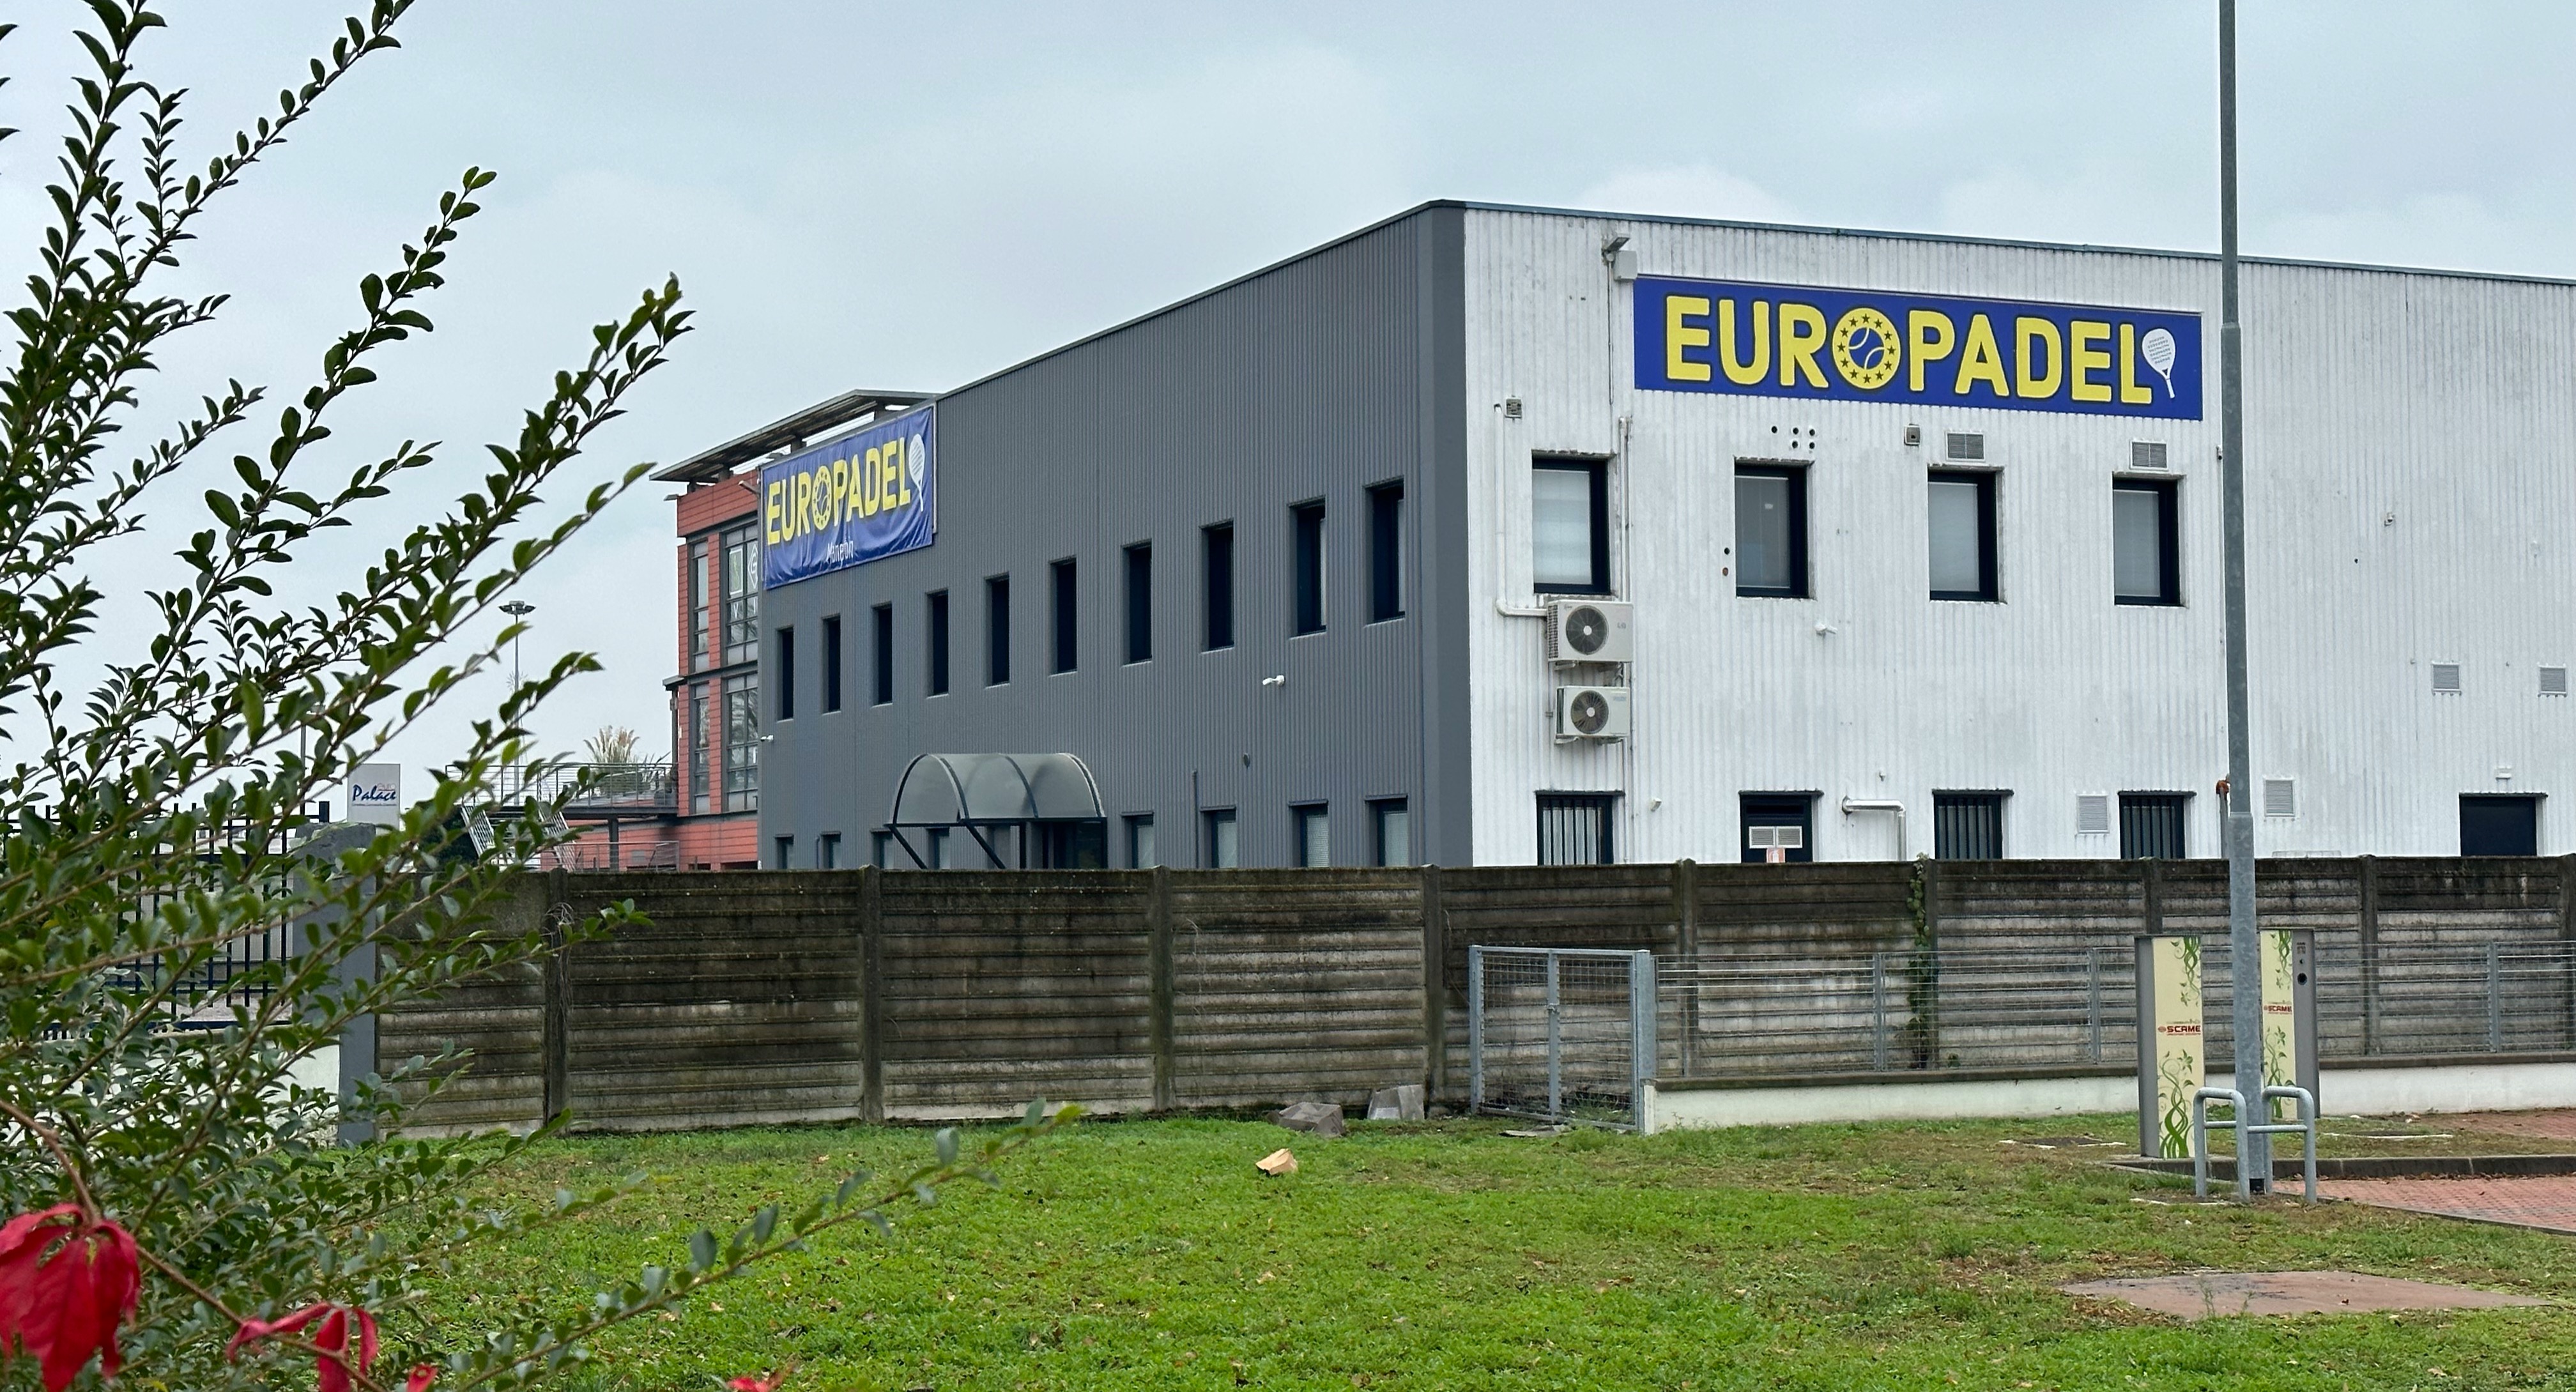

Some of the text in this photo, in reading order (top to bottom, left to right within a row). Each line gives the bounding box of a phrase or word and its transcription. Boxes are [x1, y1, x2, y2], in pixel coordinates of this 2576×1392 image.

[1666, 295, 2152, 404] EUROPADEL
[767, 437, 910, 546] EUROPADEL
[352, 784, 397, 802] Palace
